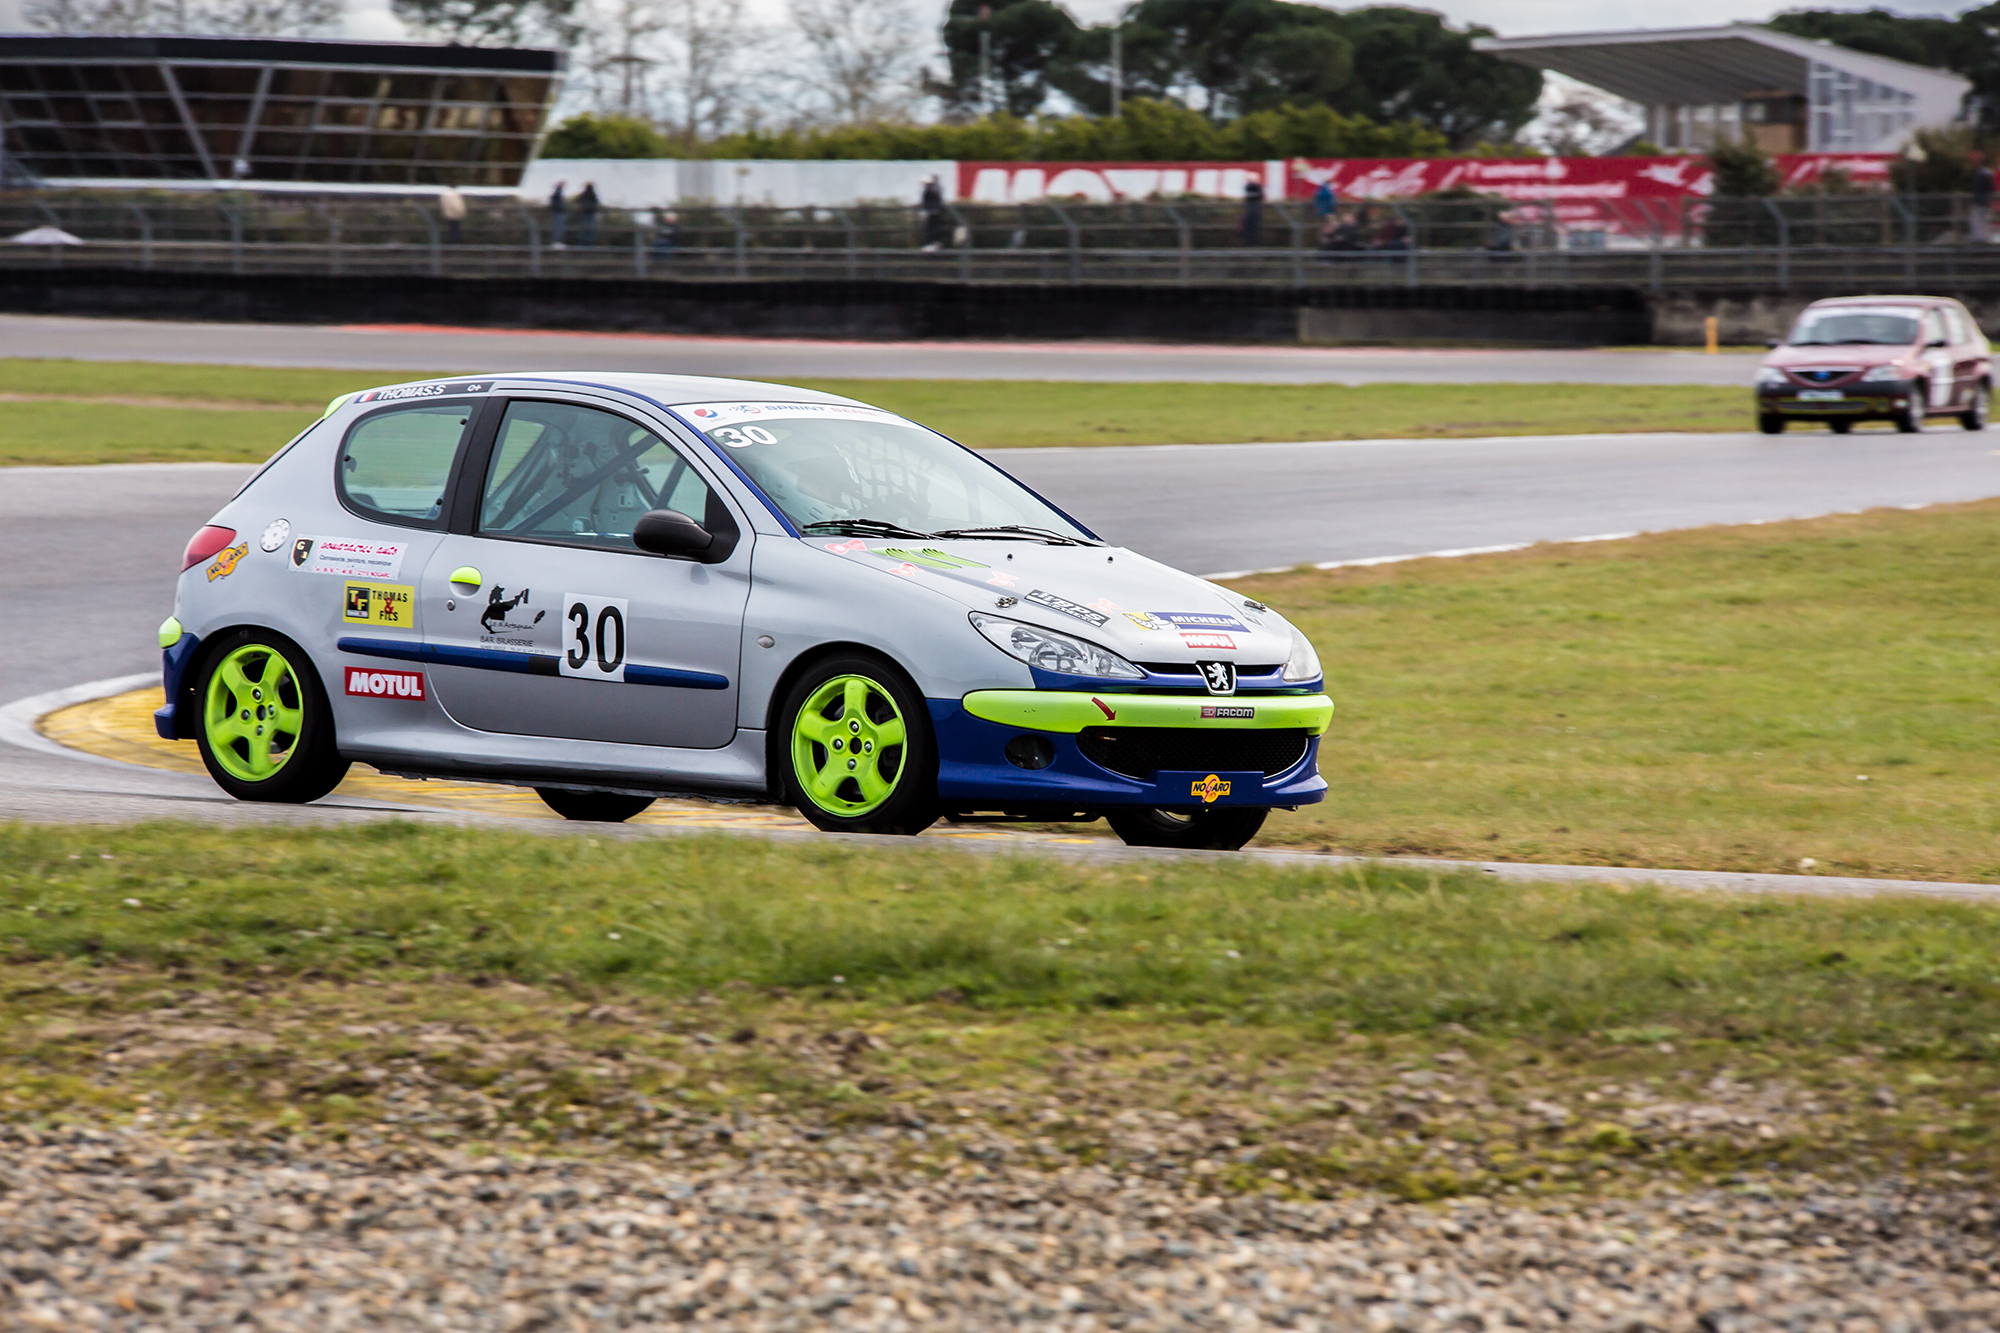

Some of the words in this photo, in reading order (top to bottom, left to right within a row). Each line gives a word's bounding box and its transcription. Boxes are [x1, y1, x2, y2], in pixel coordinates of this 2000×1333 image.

[713, 425, 778, 448] 30
[296, 541, 306, 550] G
[372, 590, 408, 603] THOMAS
[384, 597, 395, 615] &
[379, 610, 399, 622] FILS
[1170, 615, 1241, 626] MICHELIN
[480, 636, 495, 644] BAR
[496, 638, 534, 647] BRASSERIE
[567, 602, 625, 673] 30
[1184, 635, 1234, 648] MOTUL
[349, 671, 422, 697] MOTUL
[1216, 708, 1254, 717] FACOM
